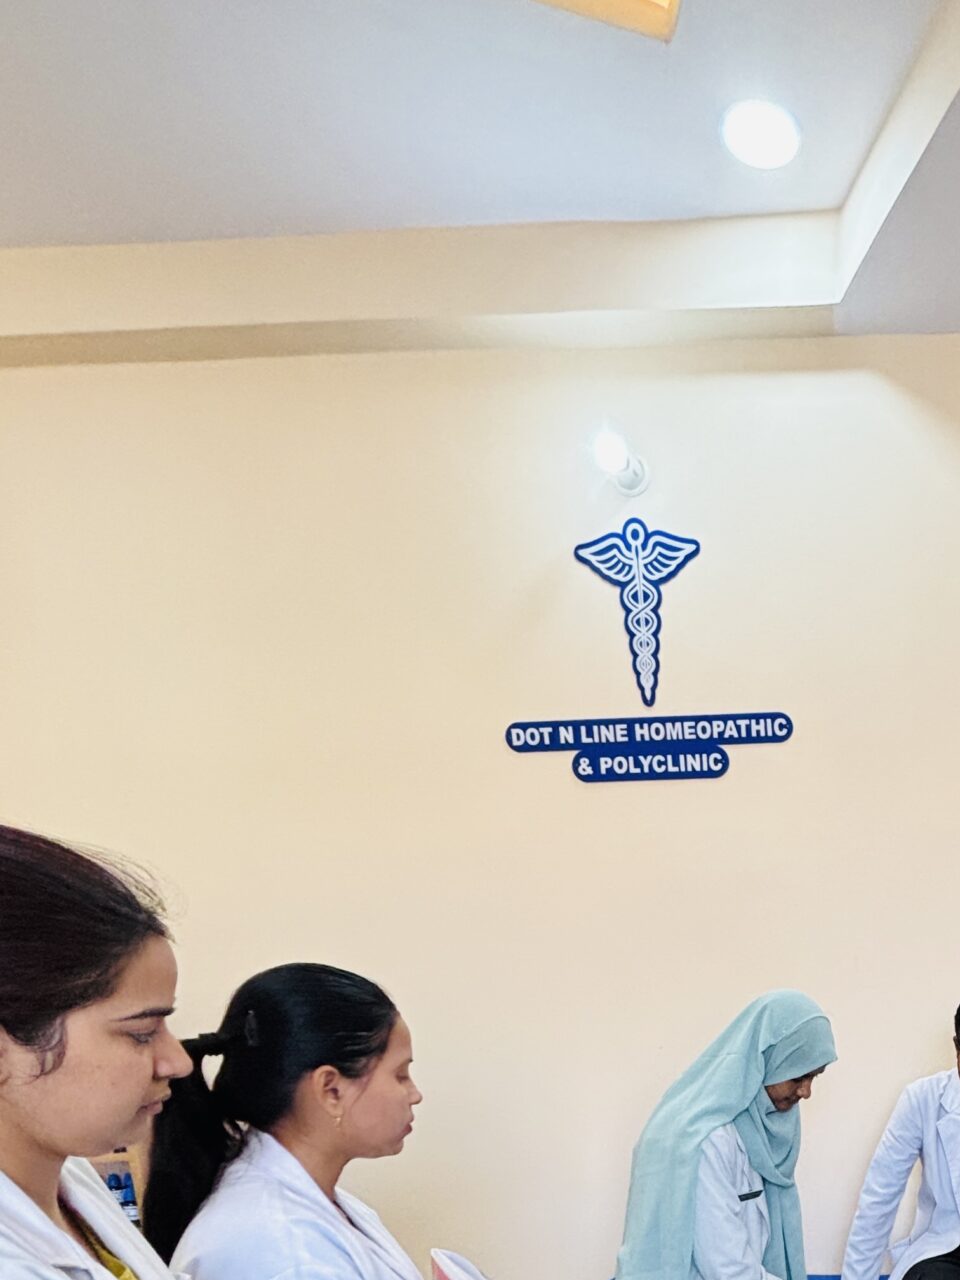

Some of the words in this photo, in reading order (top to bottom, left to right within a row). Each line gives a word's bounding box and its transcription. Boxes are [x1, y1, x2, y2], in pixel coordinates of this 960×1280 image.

[510, 727, 553, 746] DOT
[558, 725, 575, 744] N
[580, 723, 629, 743] LINE
[634, 717, 789, 742] HOMEOPATHIC
[577, 756, 594, 776] &
[599, 752, 723, 775] POLYCLINIC
